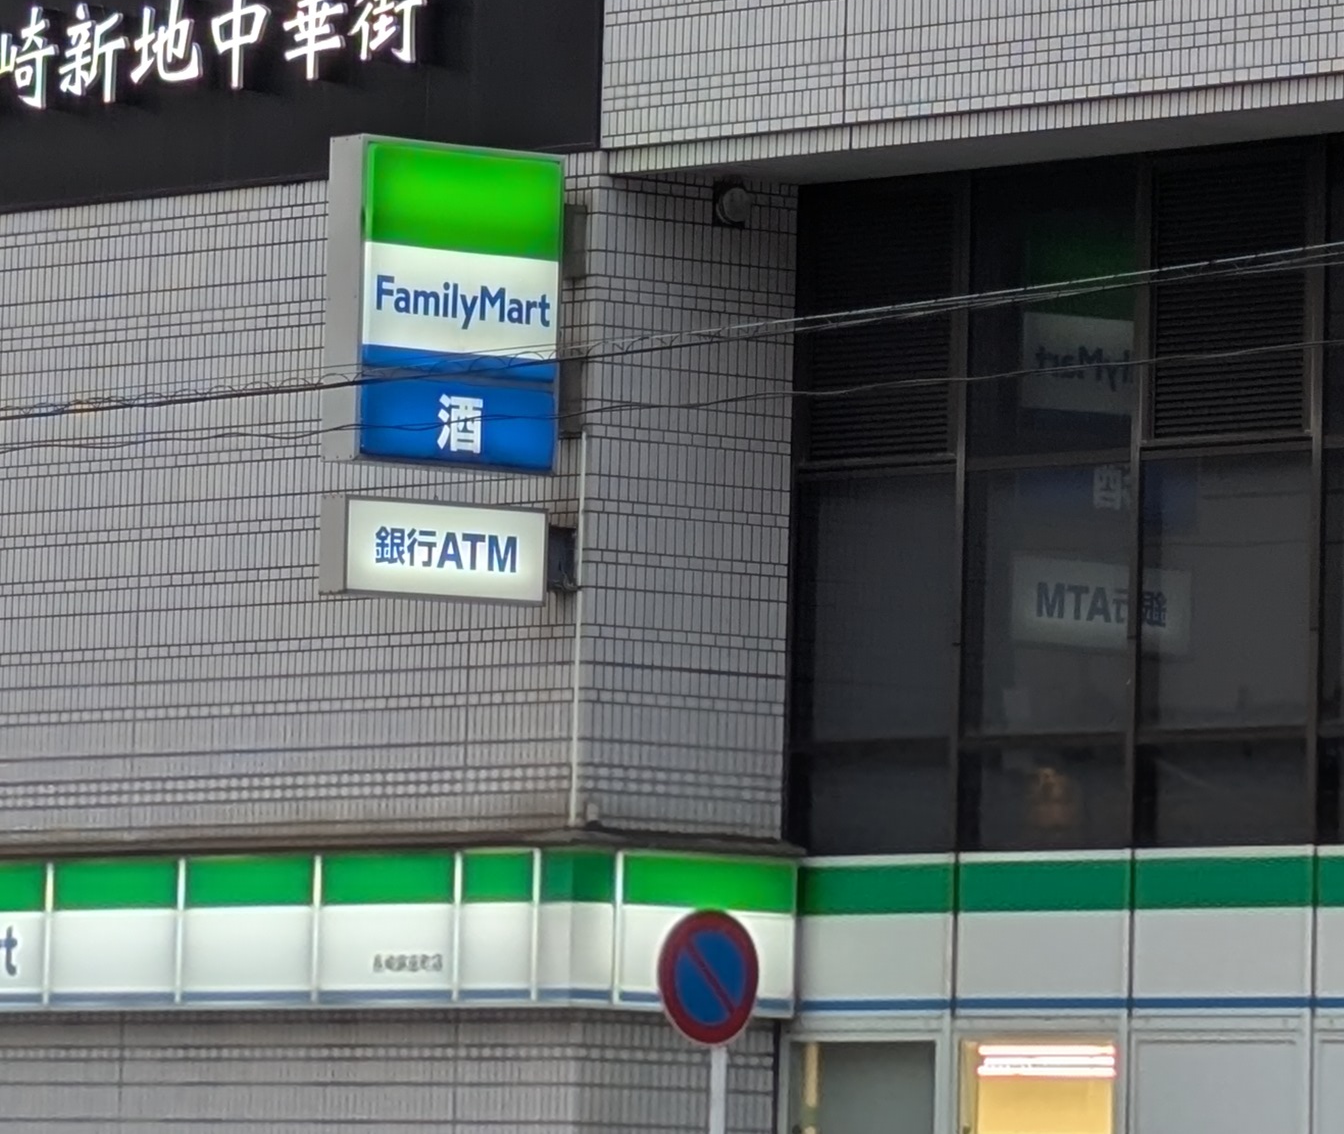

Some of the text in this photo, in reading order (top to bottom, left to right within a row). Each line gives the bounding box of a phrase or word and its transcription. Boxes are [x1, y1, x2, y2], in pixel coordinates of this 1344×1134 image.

[375, 275, 551, 330] FamilyMart
[437, 394, 484, 455] 酒
[375, 525, 518, 573] 銀行ATM
